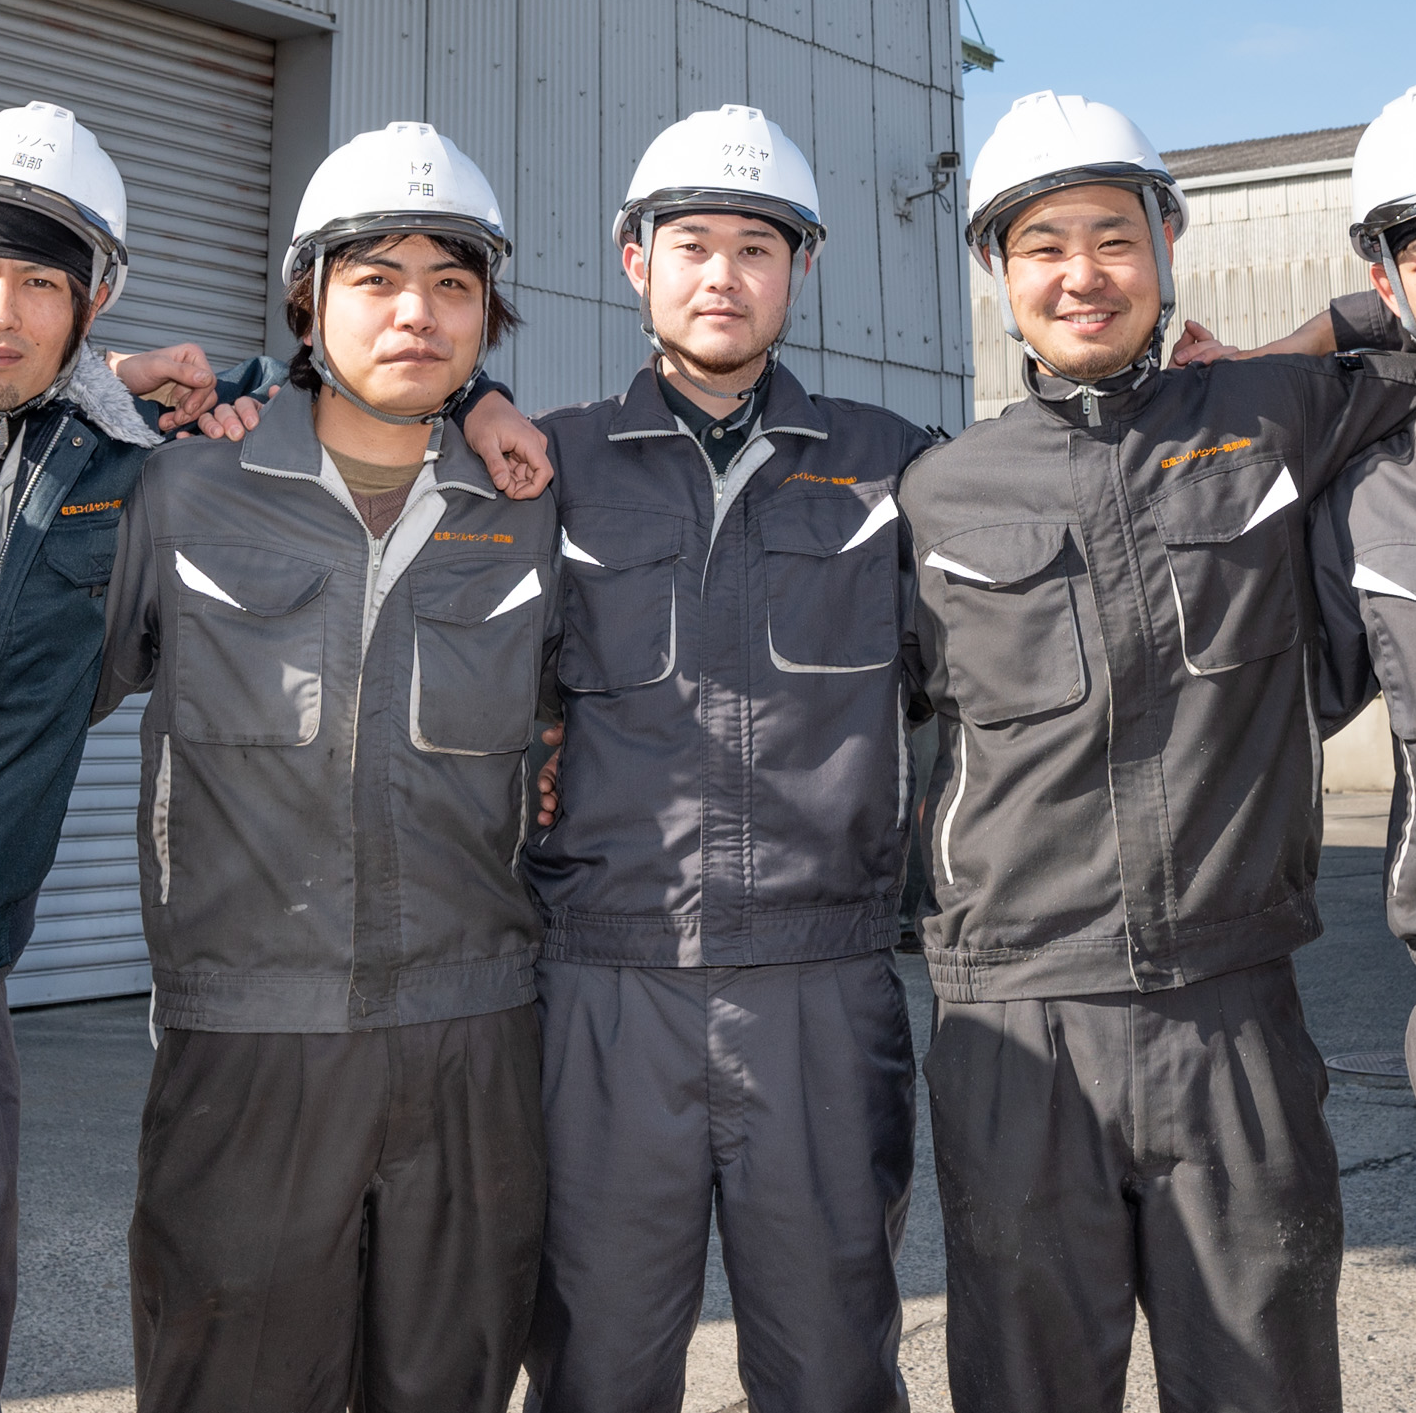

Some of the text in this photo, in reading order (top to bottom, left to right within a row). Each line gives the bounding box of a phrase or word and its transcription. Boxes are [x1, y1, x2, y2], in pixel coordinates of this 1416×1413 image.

[721, 143, 770, 162] クグミヤ
[410, 161, 433, 176] トダ
[723, 162, 761, 182] 久々宮
[407, 181, 434, 197] 戸田
